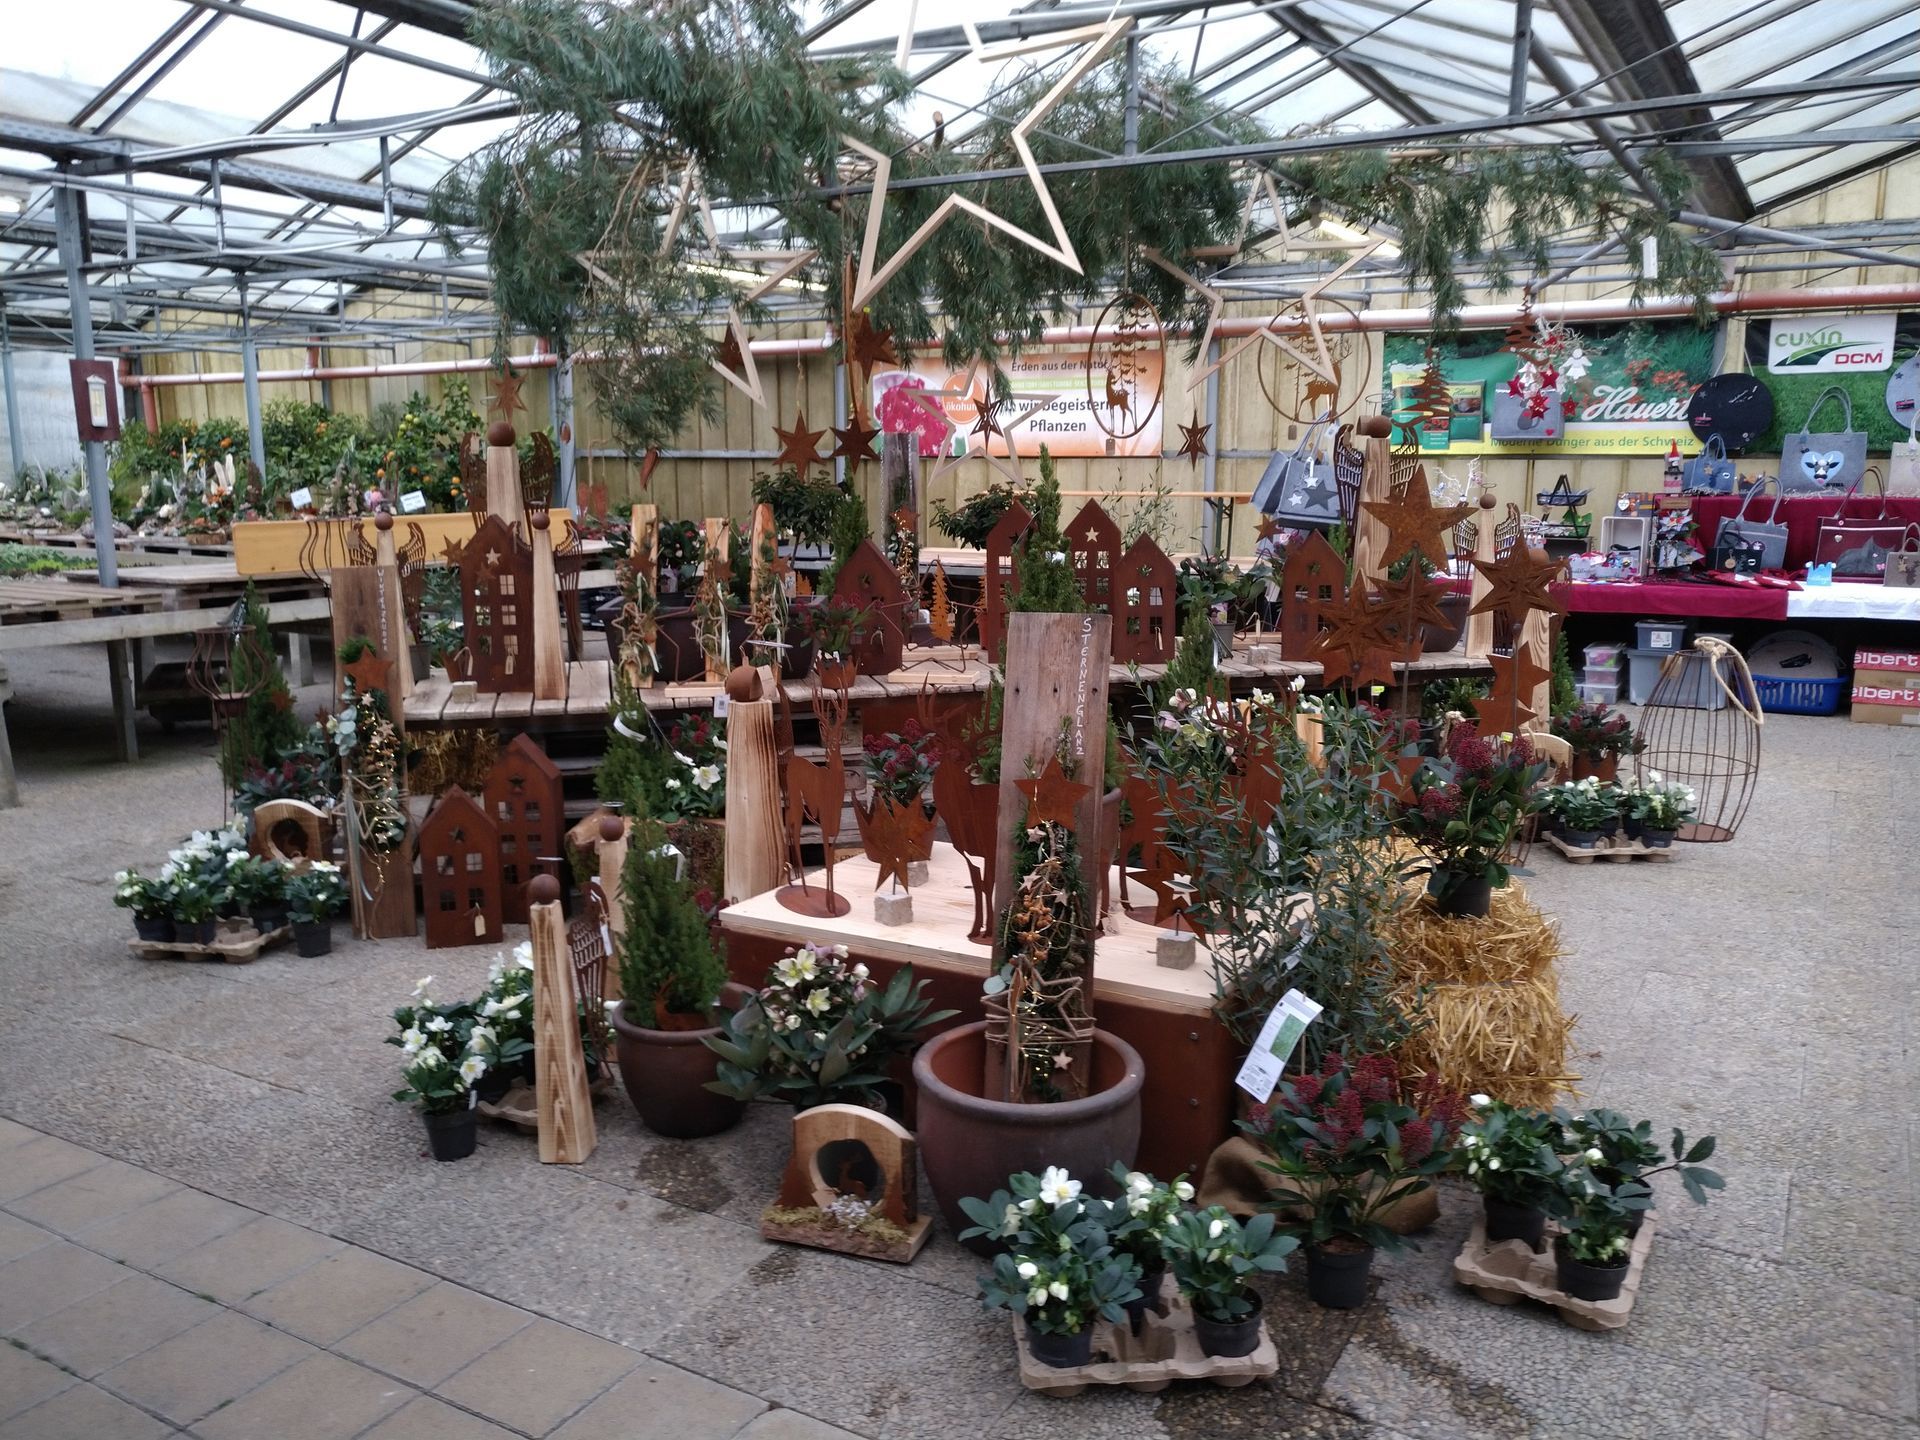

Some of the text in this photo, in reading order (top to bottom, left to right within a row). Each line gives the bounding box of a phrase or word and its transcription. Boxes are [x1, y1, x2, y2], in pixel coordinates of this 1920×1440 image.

[1834, 352, 1883, 365] DCM
[1011, 361, 1039, 372] Erden
[1041, 362, 1059, 371] aus
[1061, 360, 1077, 370] der
[1581, 385, 1691, 421] Hauert
[1030, 419, 1087, 432] Pflanzen
[1594, 438, 1614, 447] aus
[1618, 436, 1638, 446] der
[1643, 436, 1694, 447] Schweiz
[1074, 617, 1093, 755] STERNENGLANZ
